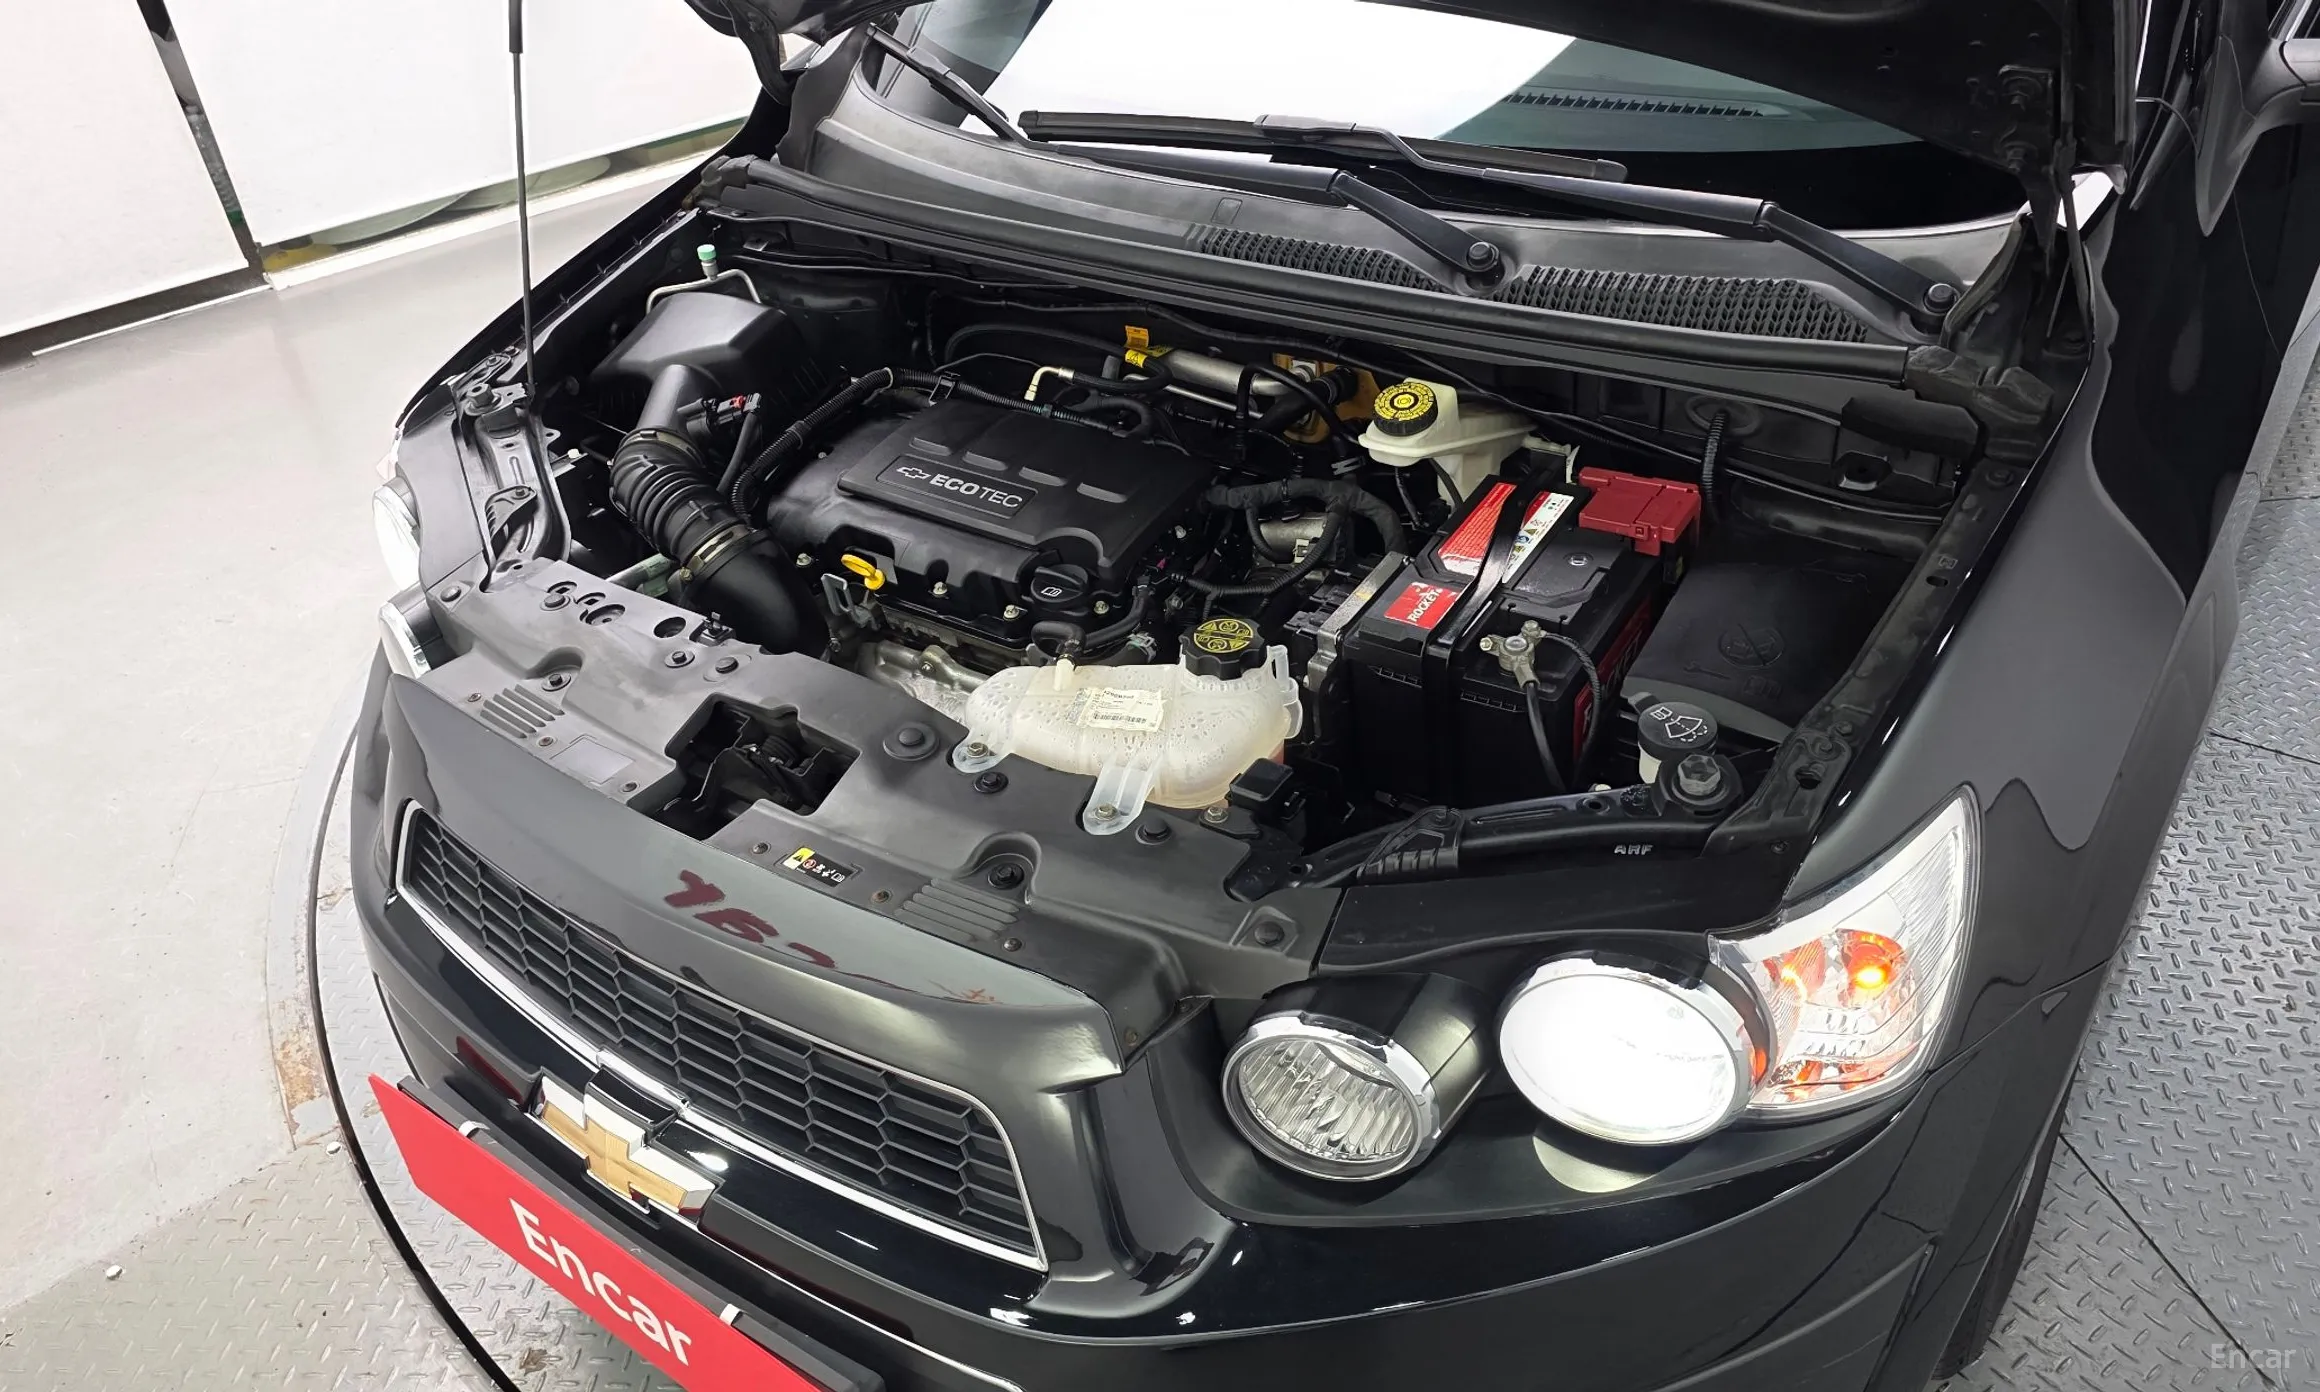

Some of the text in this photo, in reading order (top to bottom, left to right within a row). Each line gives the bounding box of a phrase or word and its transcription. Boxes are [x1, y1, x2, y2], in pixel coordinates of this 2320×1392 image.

[929, 473, 1023, 508] ECOTEC
[1407, 588, 1441, 623] ROCKET
[509, 1197, 692, 1367] Encar
